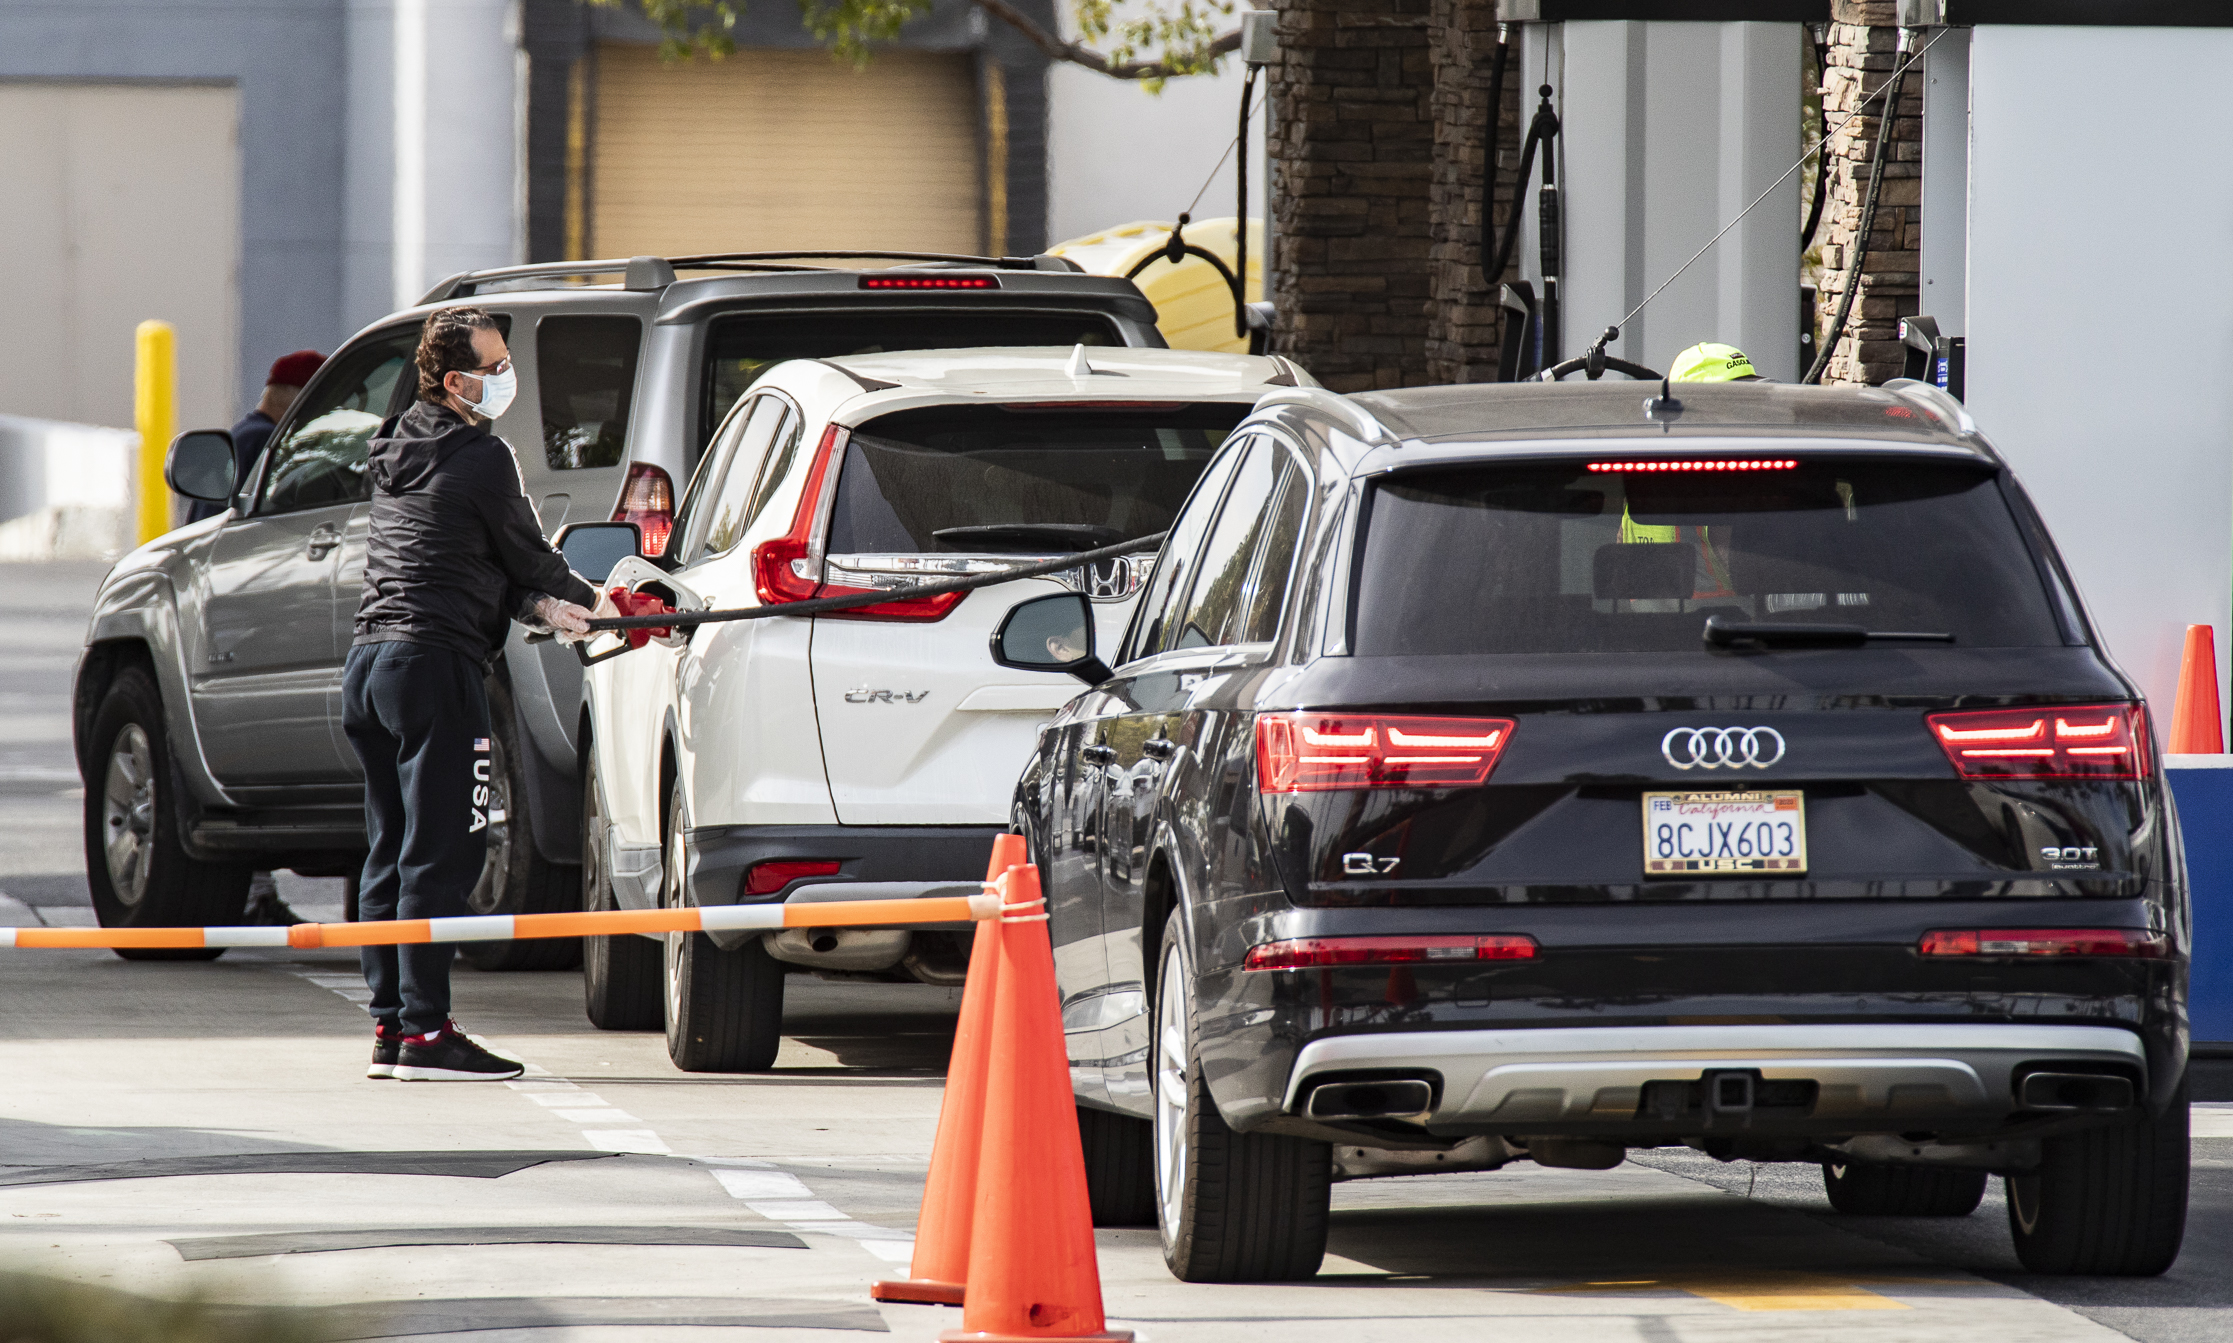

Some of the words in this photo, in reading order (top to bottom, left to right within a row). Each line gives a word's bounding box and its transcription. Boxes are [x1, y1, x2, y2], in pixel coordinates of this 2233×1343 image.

[844, 688, 930, 704] CR-V
[469, 759, 490, 833] USA
[1687, 793, 1760, 801] ALUMNI
[1653, 800, 1672, 811] FEB
[1679, 803, 1775, 820] California
[1657, 822, 1793, 858] 8CJX603
[1343, 853, 1400, 873] Q7
[1699, 859, 1753, 871] USC
